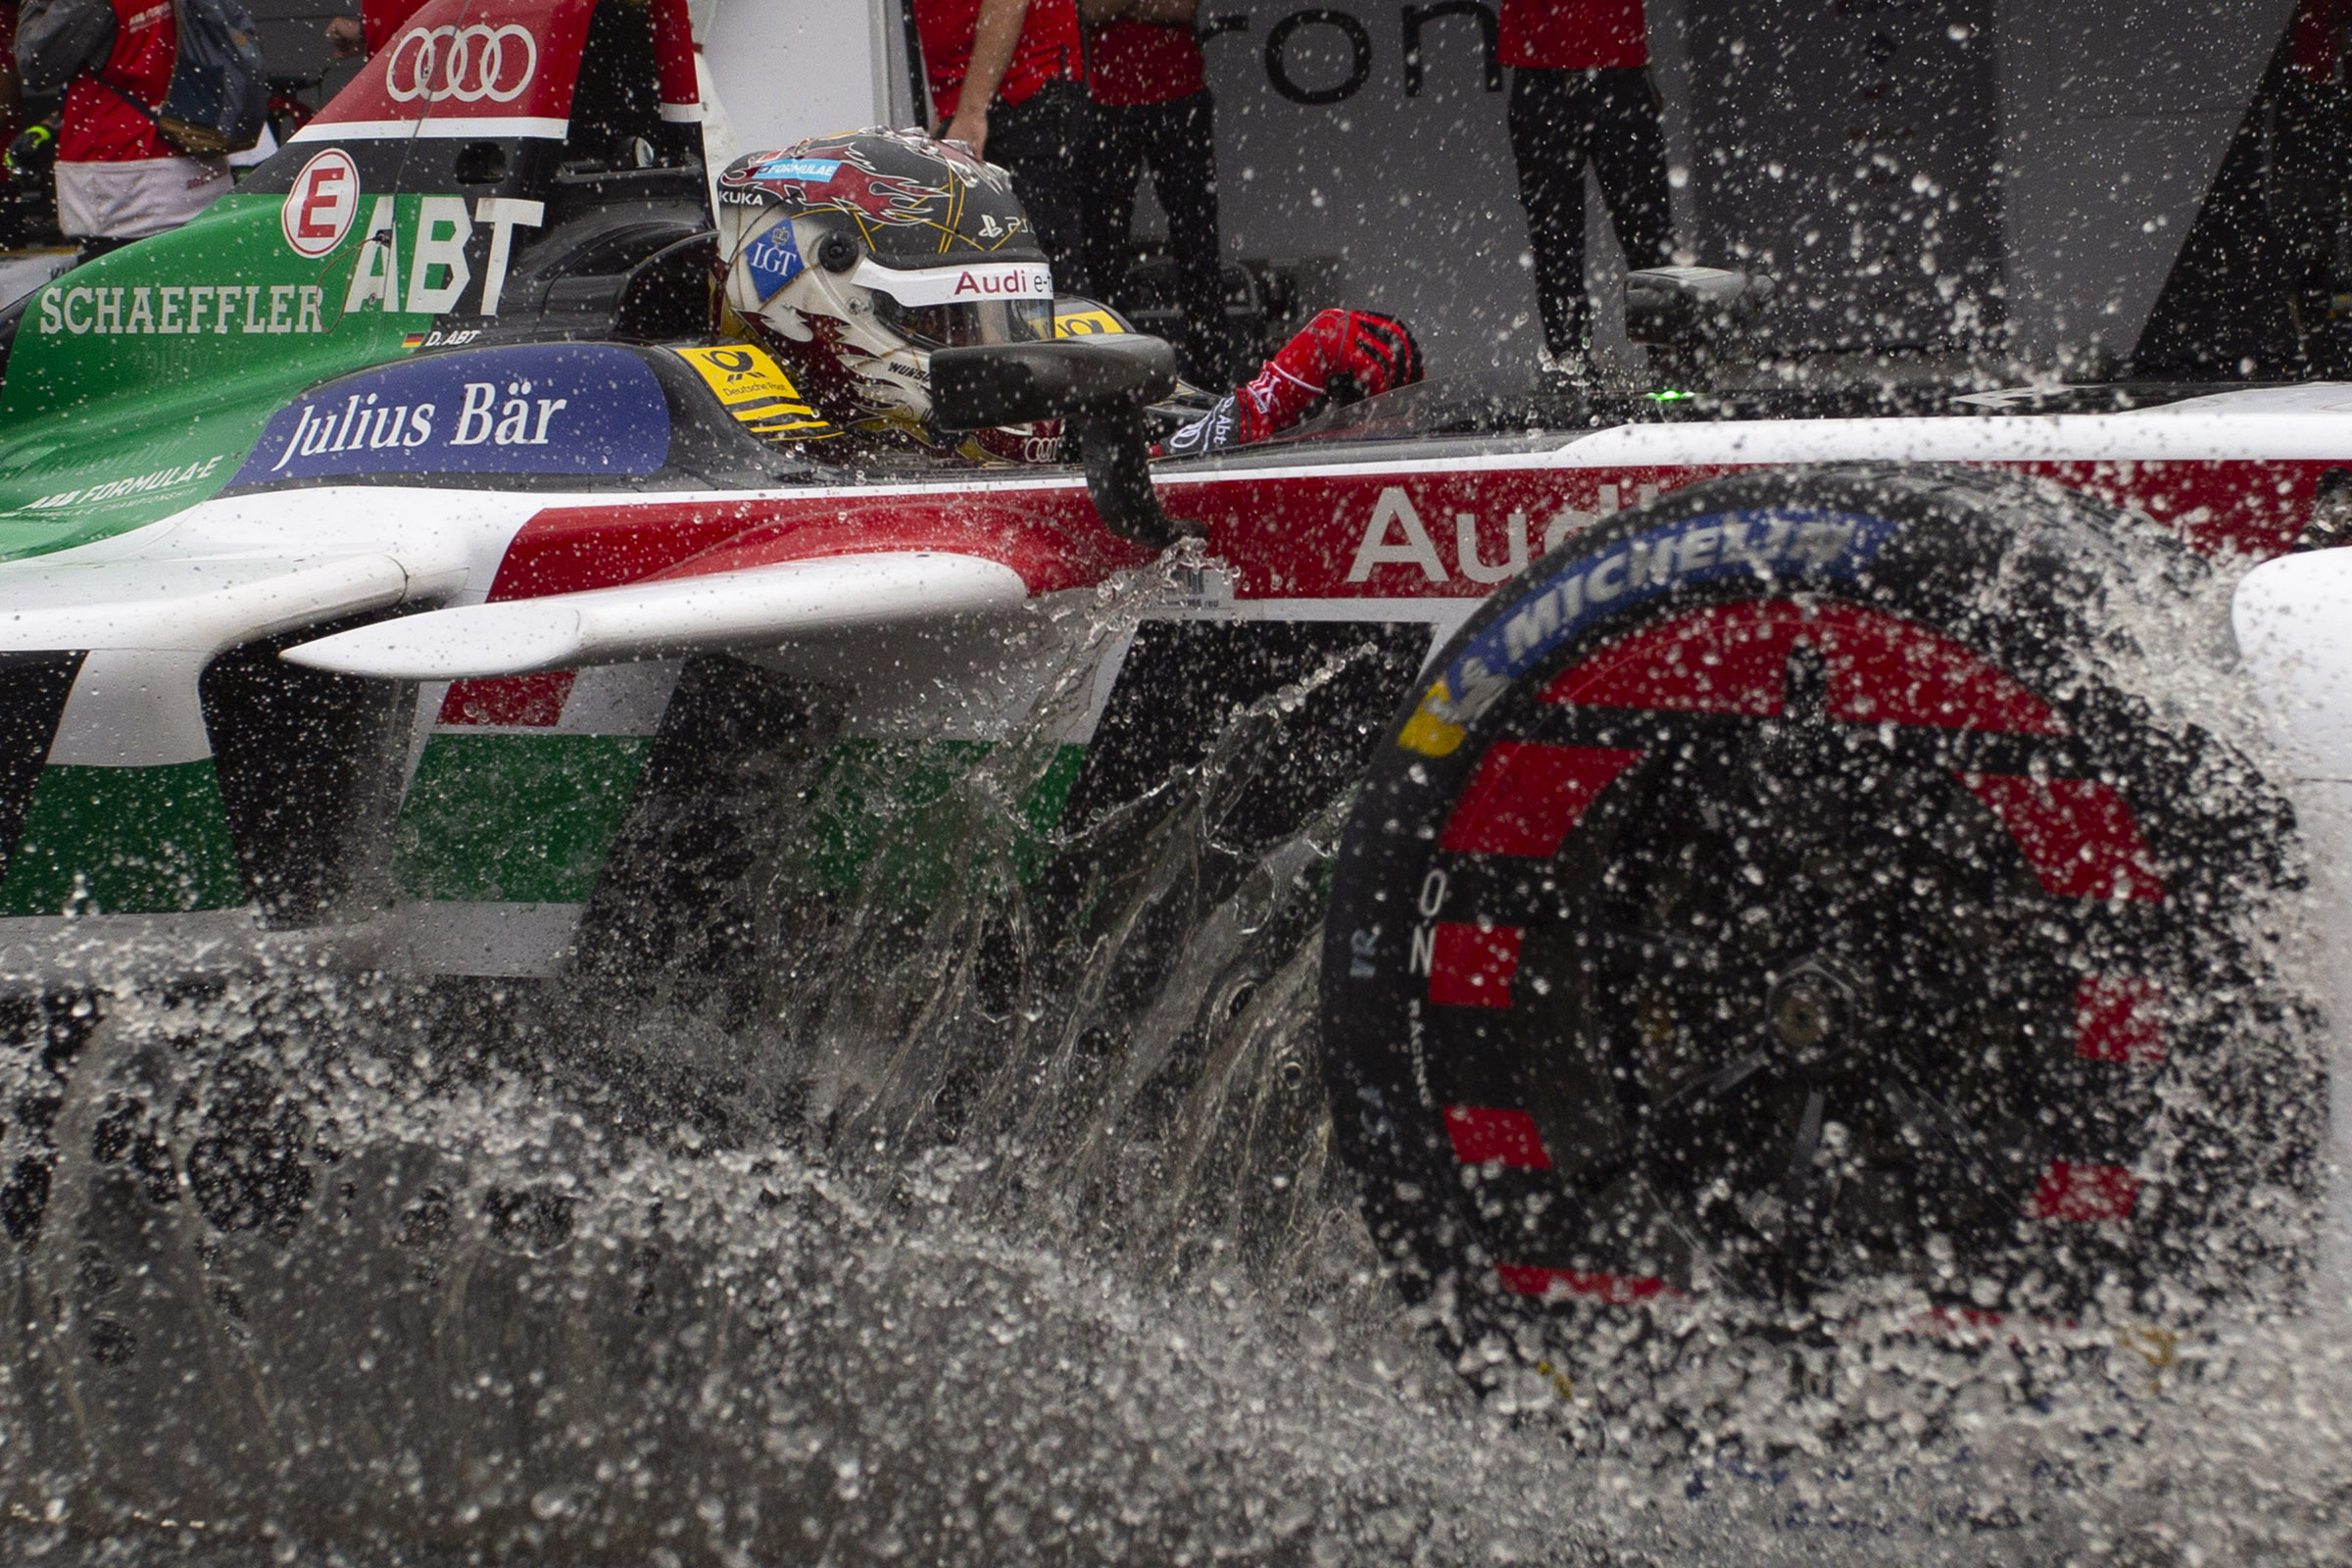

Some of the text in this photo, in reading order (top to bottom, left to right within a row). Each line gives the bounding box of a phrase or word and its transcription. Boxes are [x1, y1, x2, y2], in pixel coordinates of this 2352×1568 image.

[298, 167, 345, 239] E
[718, 191, 763, 206] KUKA
[343, 196, 545, 316] ABT
[751, 242, 797, 276] LGT
[955, 270, 1027, 296] Audi
[40, 285, 324, 335] SCHAEFFLER
[424, 330, 481, 346] D. ABT
[723, 382, 767, 397] Deutsche
[272, 381, 567, 471] Julius Bär
[1346, 484, 1659, 586] Au
[1503, 519, 1858, 664] MICHELIN
